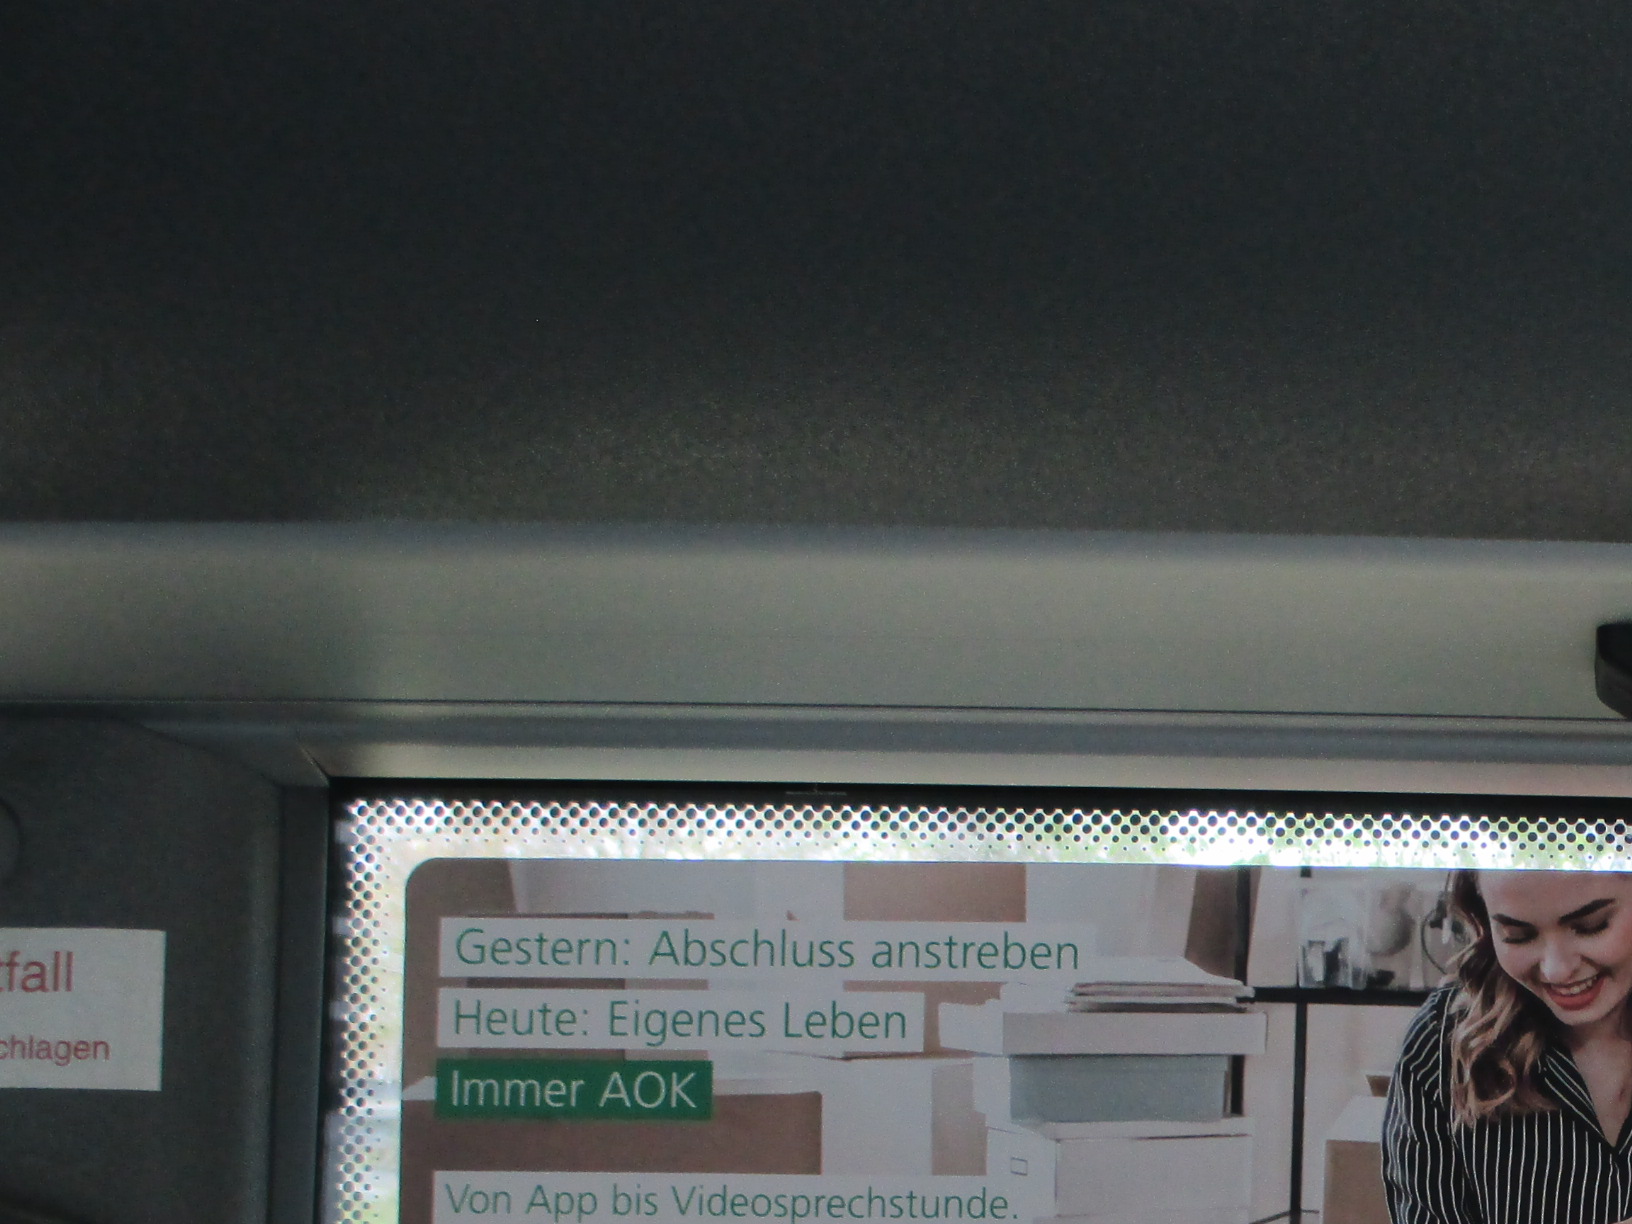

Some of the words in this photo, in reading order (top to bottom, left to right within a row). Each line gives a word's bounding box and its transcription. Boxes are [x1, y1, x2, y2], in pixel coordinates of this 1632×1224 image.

[454, 929, 631, 966] Gestern:
[649, 929, 855, 968] Abschluss
[872, 932, 1080, 971] anstreben
[455, 1001, 588, 1037] Heute:
[609, 1001, 766, 1046] Eigenes
[784, 1001, 907, 1040] Leben
[451, 1071, 584, 1107] Immer
[600, 1071, 697, 1108] AOK
[446, 1184, 512, 1215] Von
[526, 1186, 598, 1221] App
[612, 1185, 658, 1216] bis
[673, 1187, 1020, 1224] Videosprechstunde.
